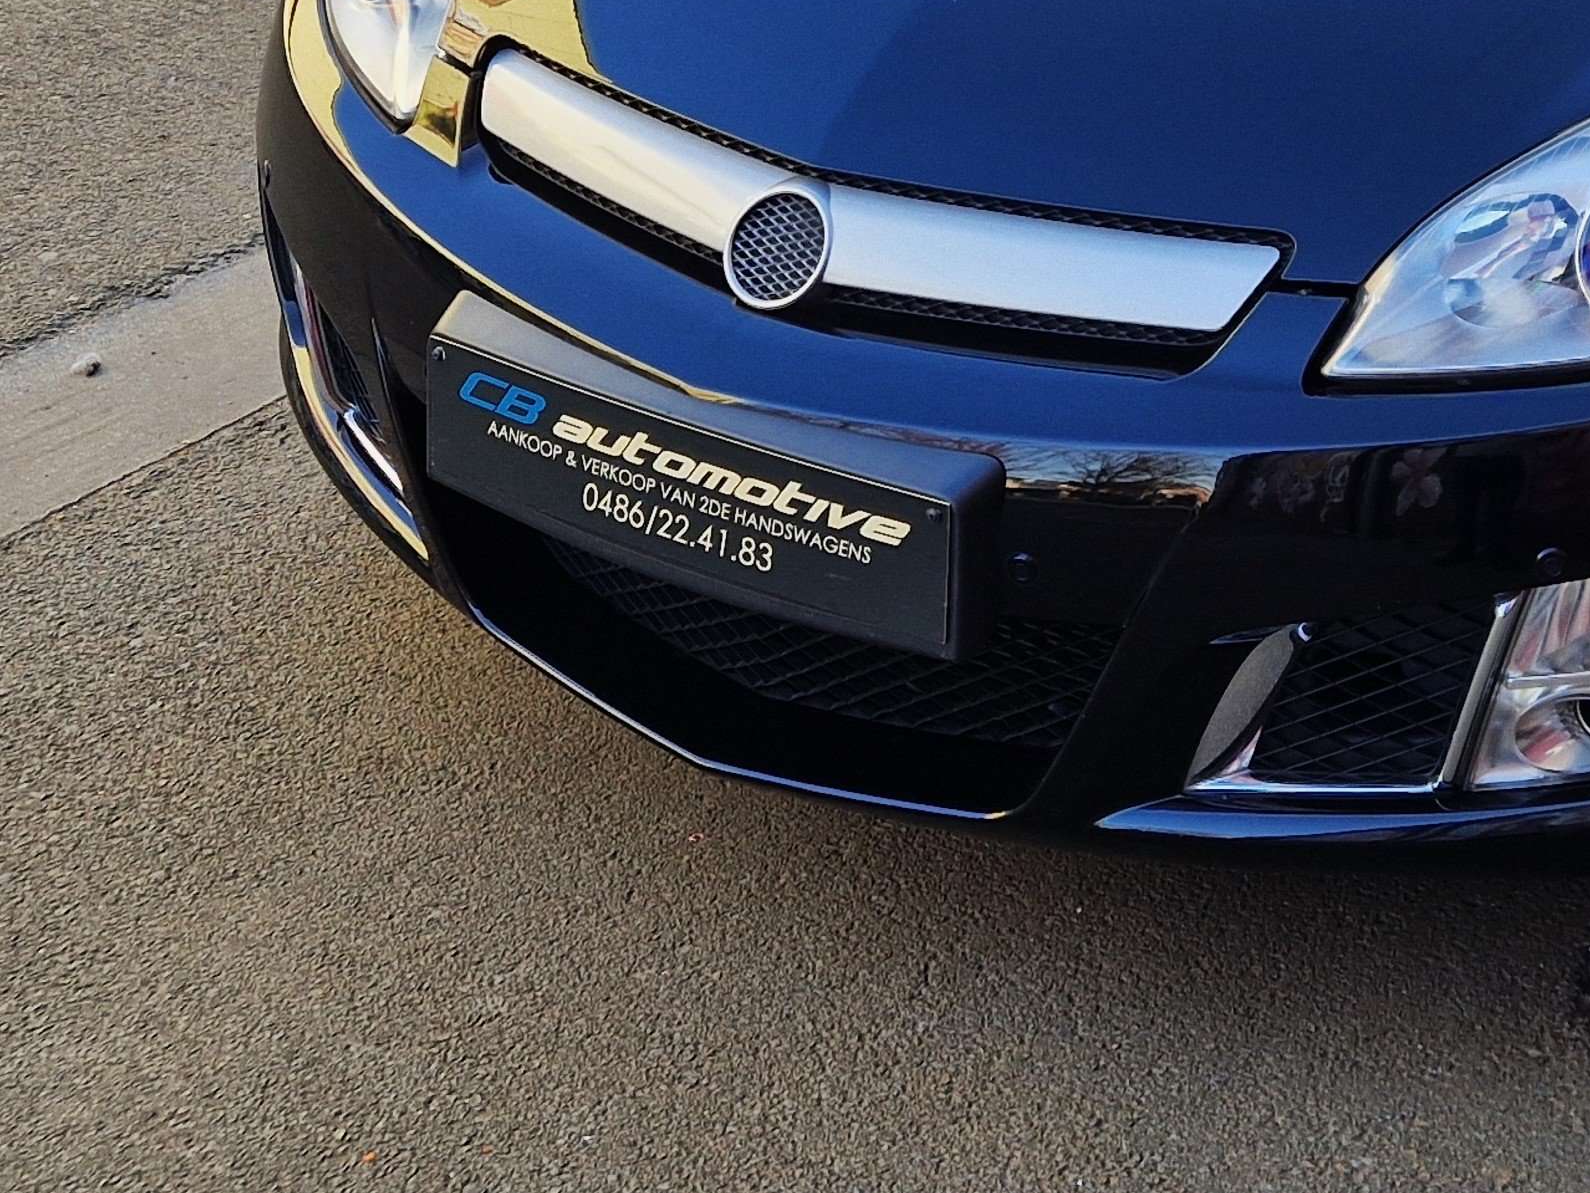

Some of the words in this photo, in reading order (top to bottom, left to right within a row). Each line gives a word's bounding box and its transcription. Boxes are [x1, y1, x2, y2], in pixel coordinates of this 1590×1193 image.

[459, 371, 547, 425] CB
[552, 414, 912, 547] automotive
[487, 420, 562, 461] AANKOOP
[565, 450, 577, 468] &
[581, 454, 656, 494] VERKOOP
[660, 482, 695, 509] VAN
[699, 495, 732, 521] 2DE
[734, 506, 872, 565] HANDSWAGENS
[582, 482, 774, 572] 0486/22.41.83
